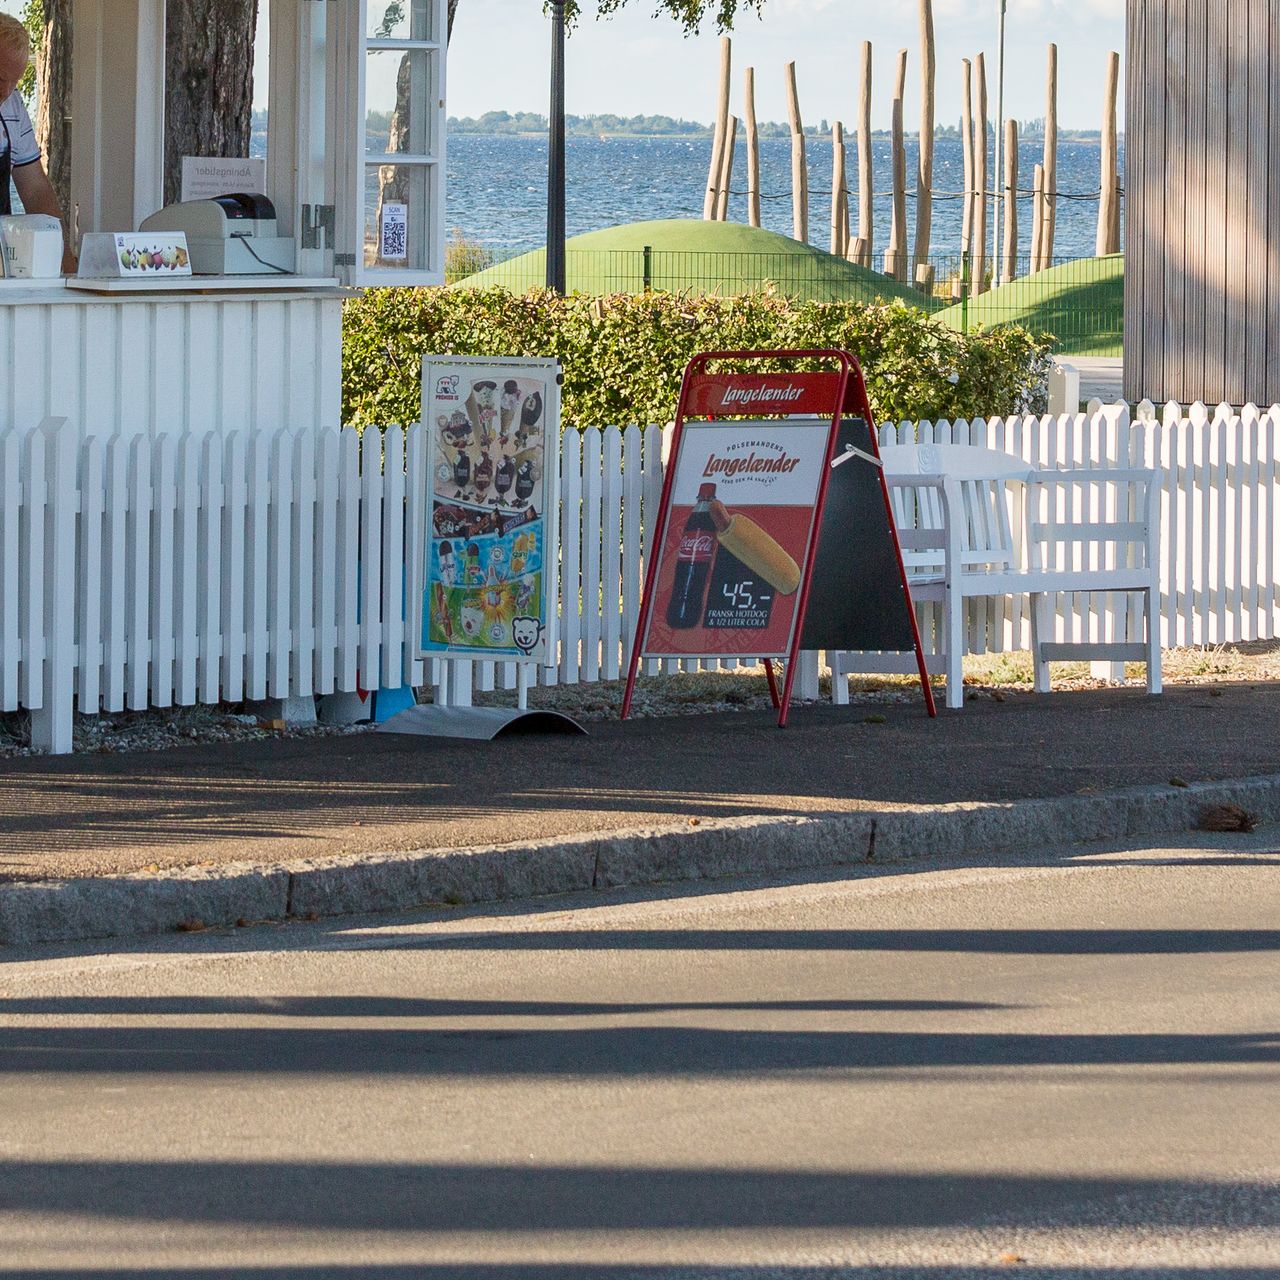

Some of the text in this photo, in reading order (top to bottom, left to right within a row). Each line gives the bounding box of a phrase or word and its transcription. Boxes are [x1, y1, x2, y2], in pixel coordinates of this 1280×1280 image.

[721, 383, 805, 405] Langelænder
[726, 440, 784, 452] PØLSEMANDENS
[702, 451, 801, 477] Langelænder
[722, 581, 770, 609] 45,-
[708, 610, 768, 618] FRANSK HOTDOG
